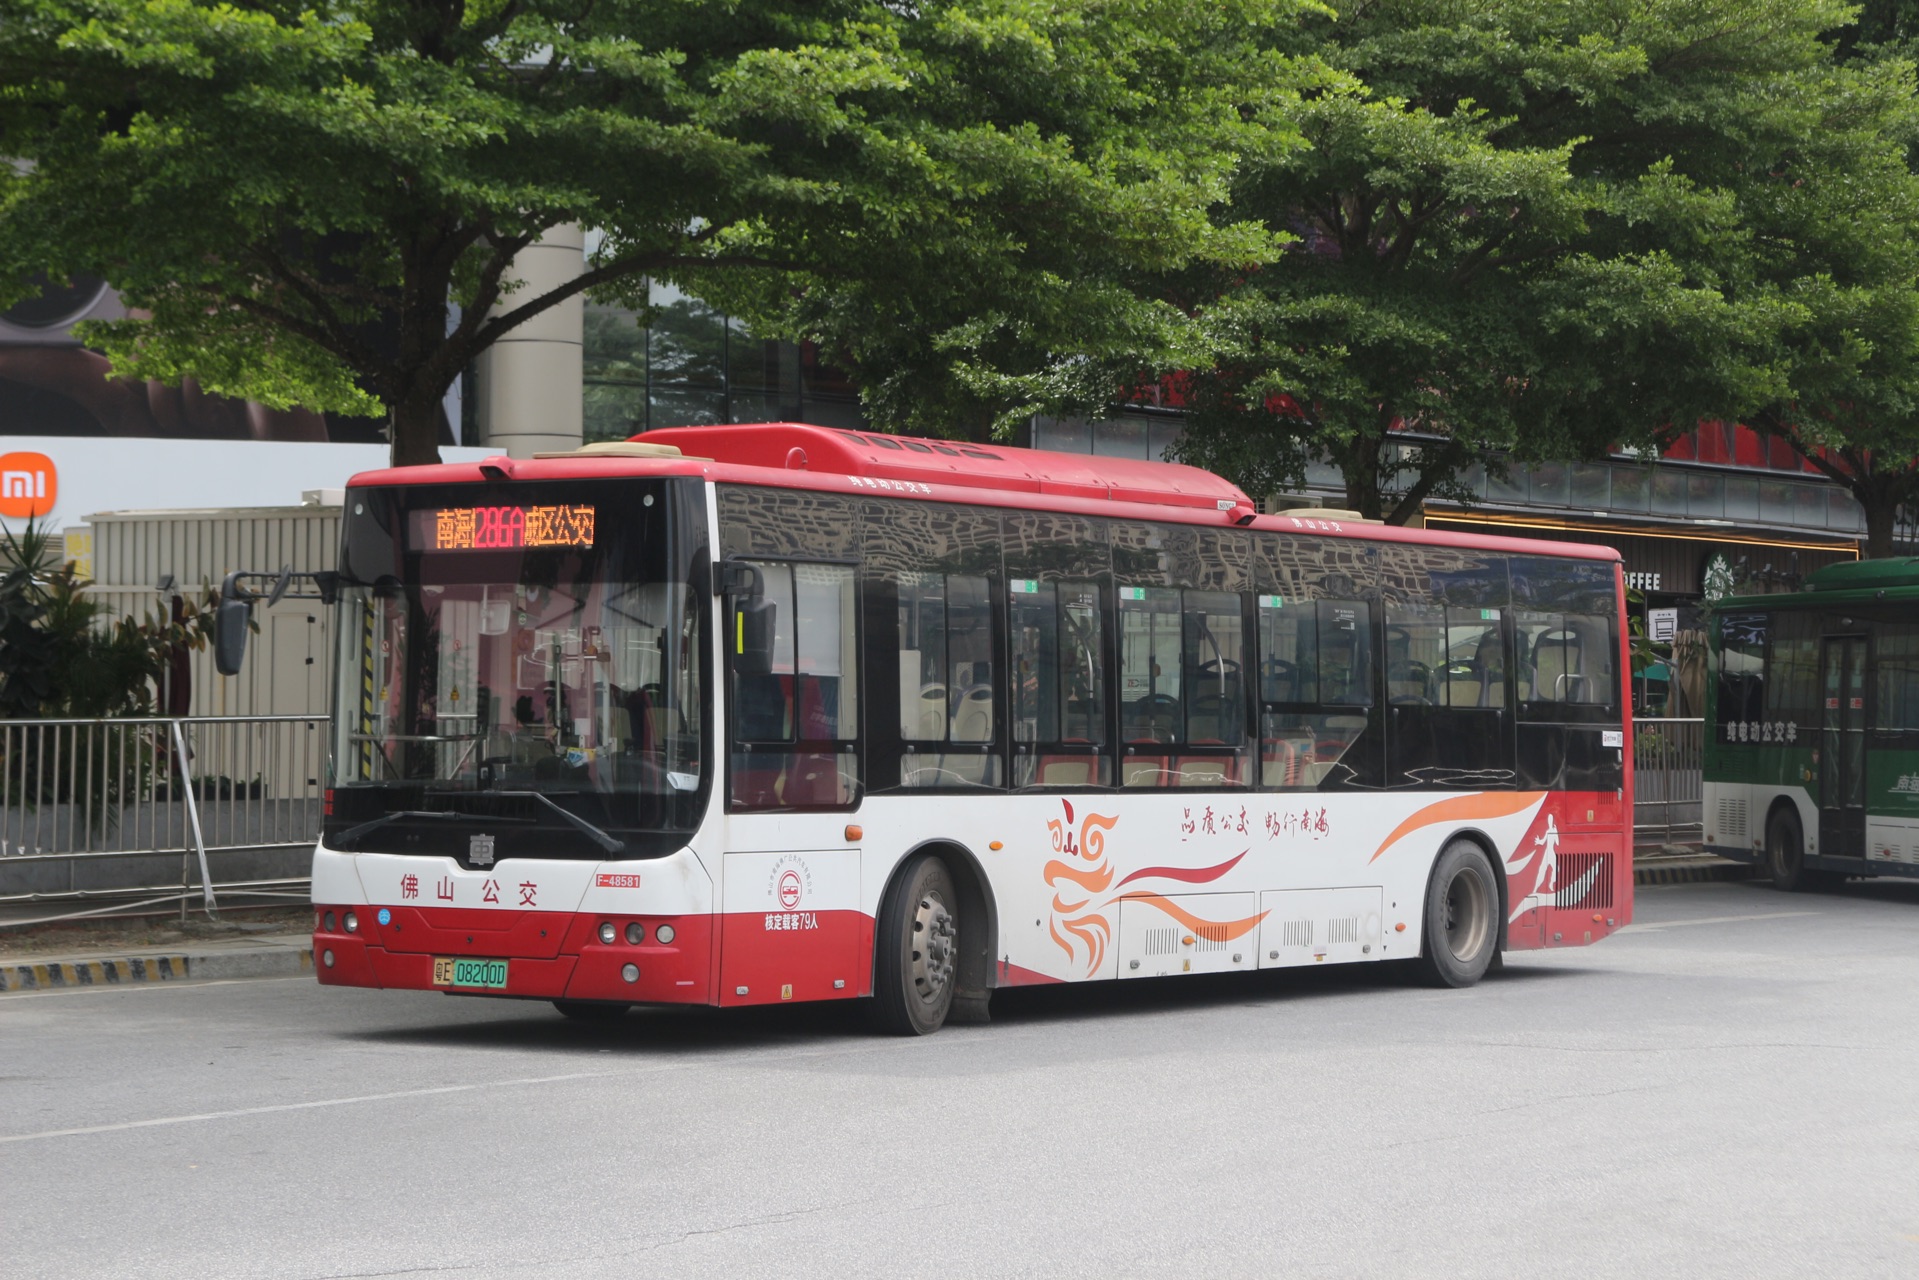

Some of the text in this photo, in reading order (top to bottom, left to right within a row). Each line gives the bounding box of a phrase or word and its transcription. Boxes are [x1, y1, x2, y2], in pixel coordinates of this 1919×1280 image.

[436, 508, 476, 549] 南海
[1727, 721, 1797, 743] 纯电动公交车
[1181, 805, 1250, 836] 品质公交
[400, 874, 537, 907] 佛山公交
[597, 875, 639, 887] F-48581
[764, 913, 818, 931] 核定载客79人
